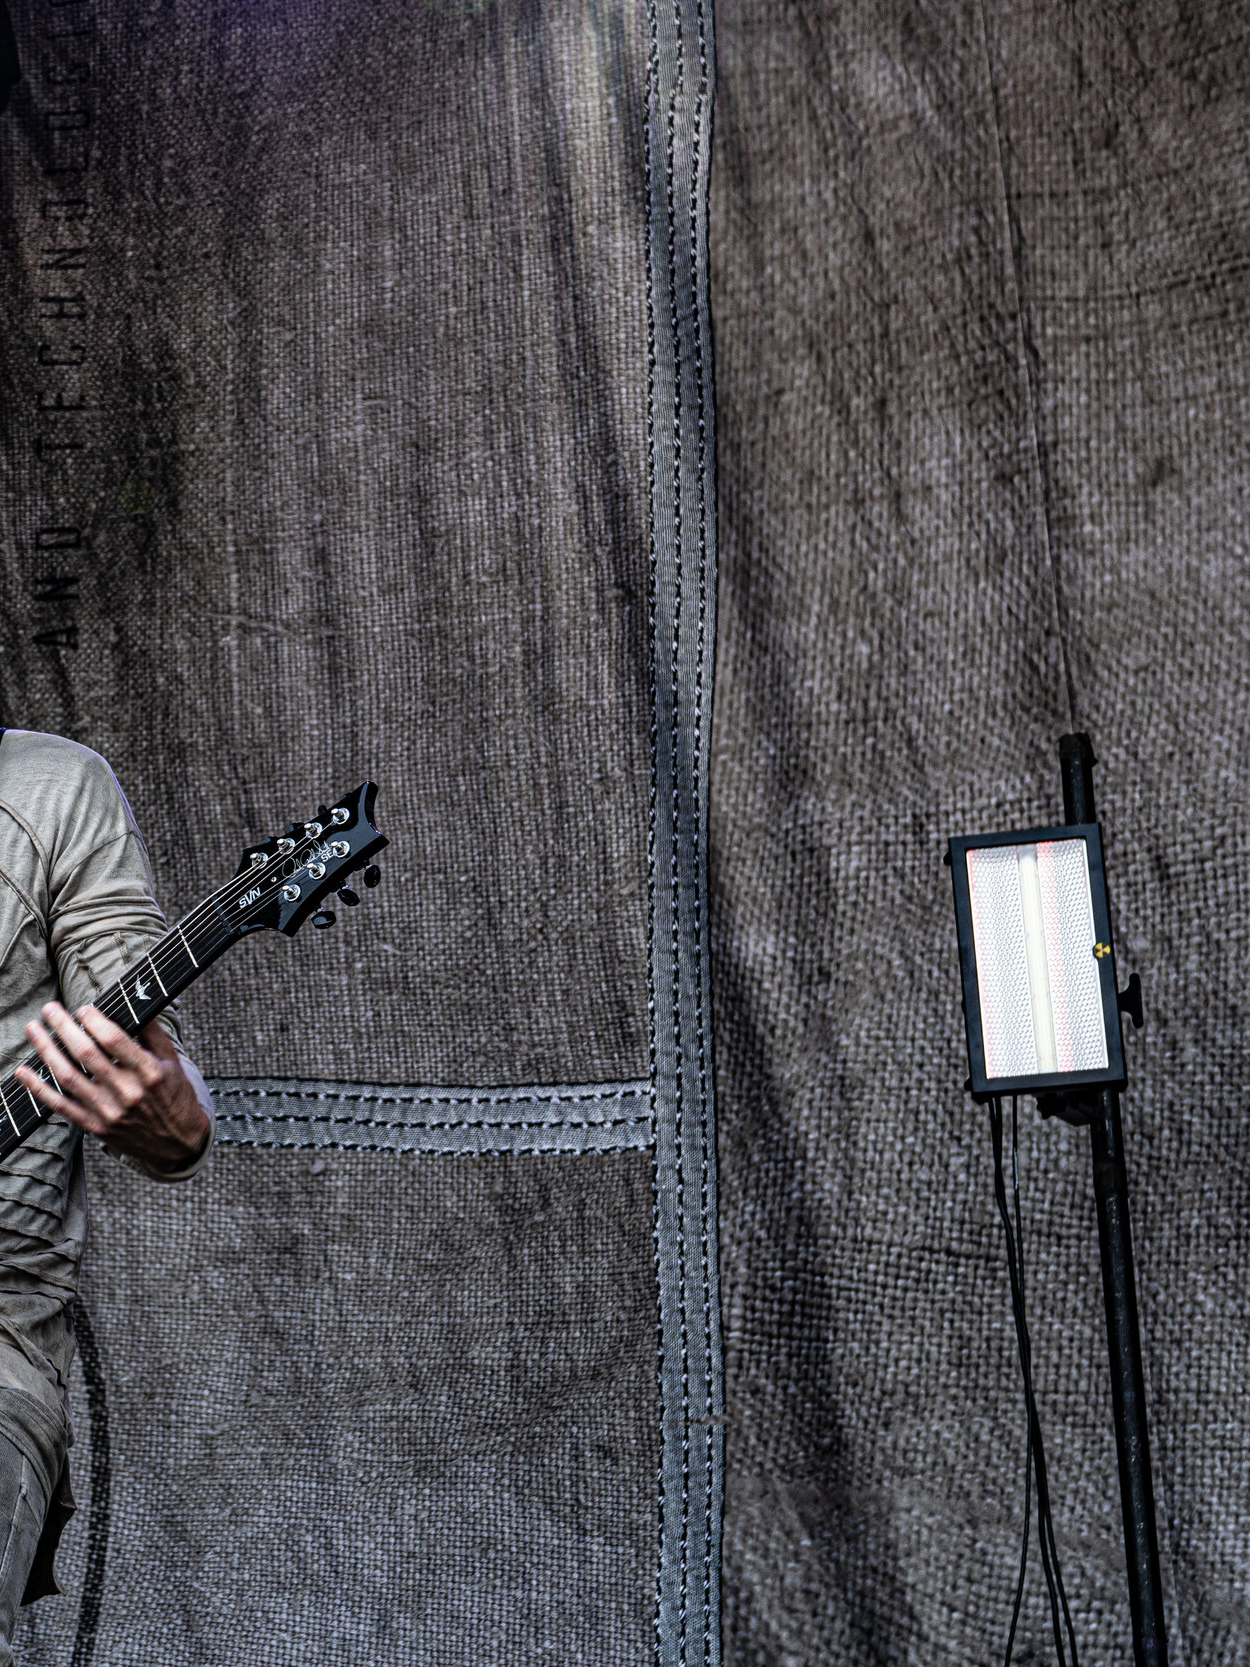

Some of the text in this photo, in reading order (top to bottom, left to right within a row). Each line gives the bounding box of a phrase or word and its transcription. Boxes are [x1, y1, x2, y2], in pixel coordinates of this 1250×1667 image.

[33, 0, 92, 650] AND TECHNOLOGI
[239, 886, 261, 910] SVN
